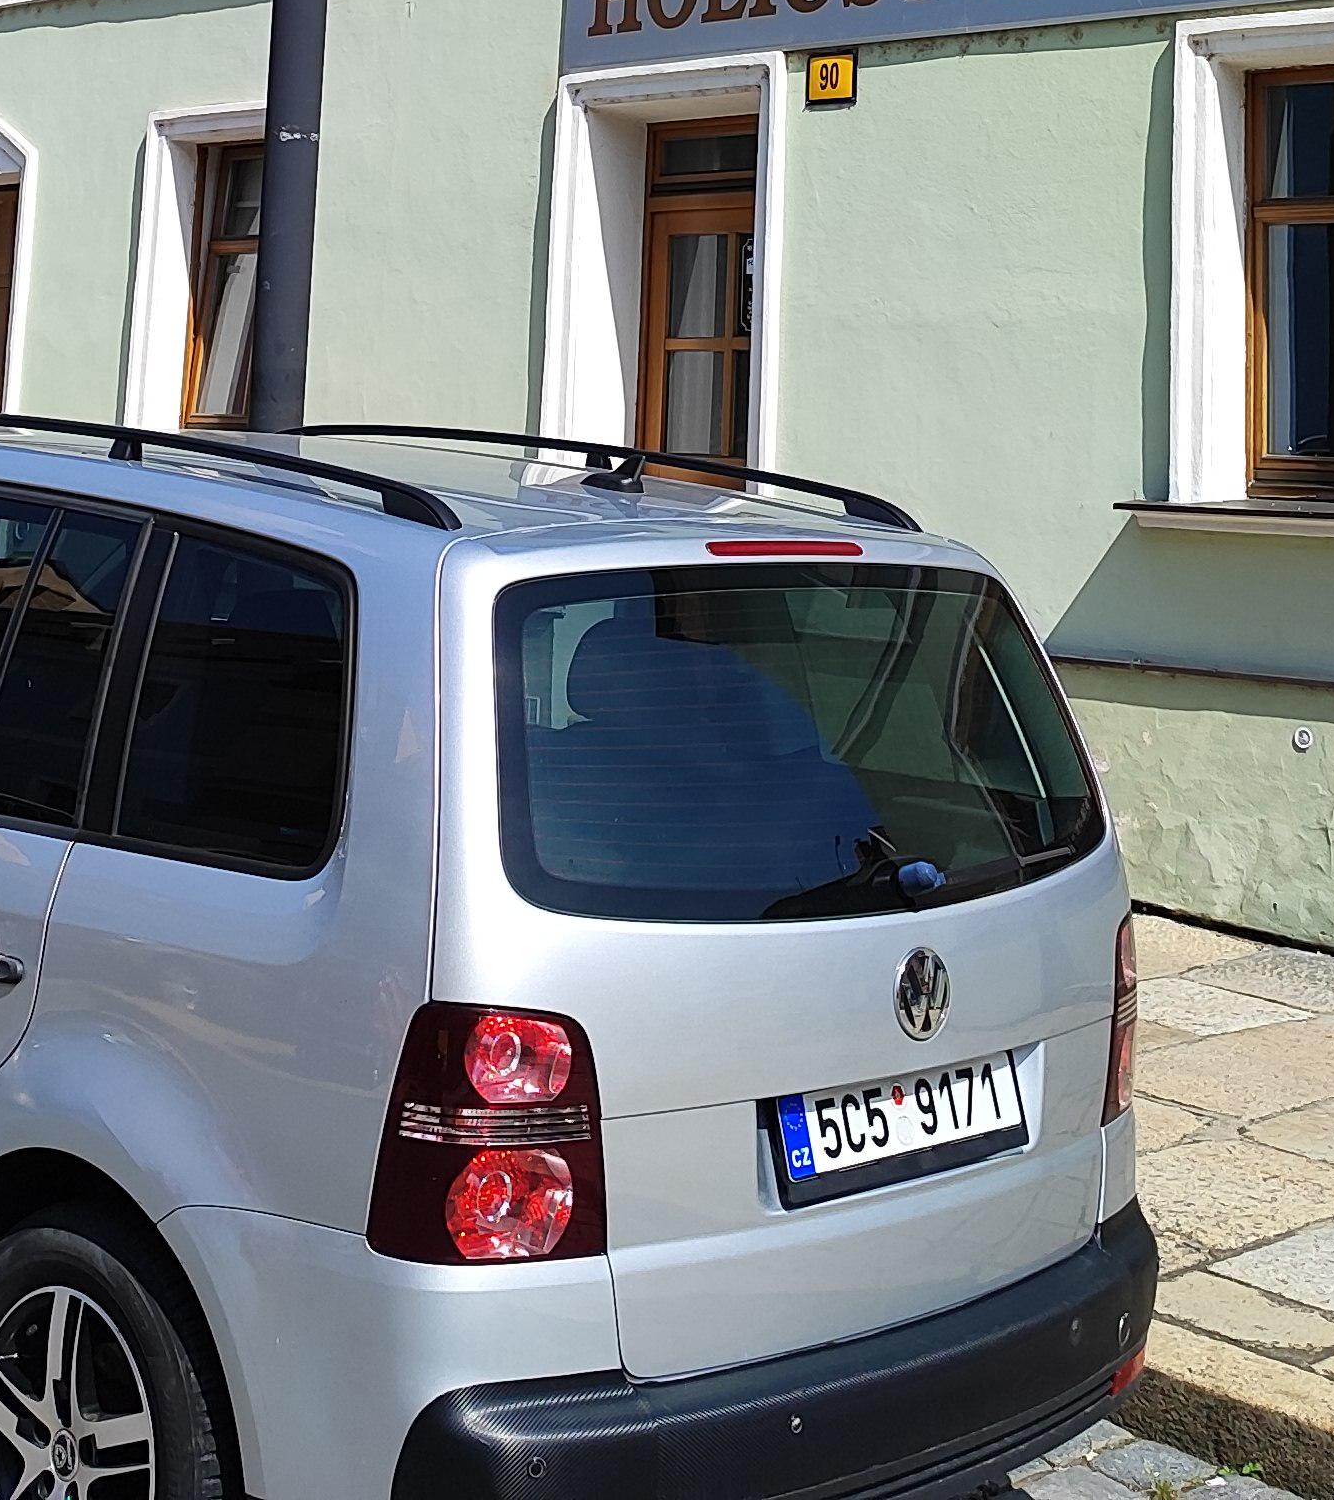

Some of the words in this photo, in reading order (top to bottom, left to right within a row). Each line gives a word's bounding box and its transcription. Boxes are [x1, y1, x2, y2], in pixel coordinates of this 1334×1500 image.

[819, 62, 839, 91] 90
[815, 1087, 889, 1159] 5C5
[914, 1063, 1002, 1136] 9171
[791, 1146, 812, 1168] CZ
